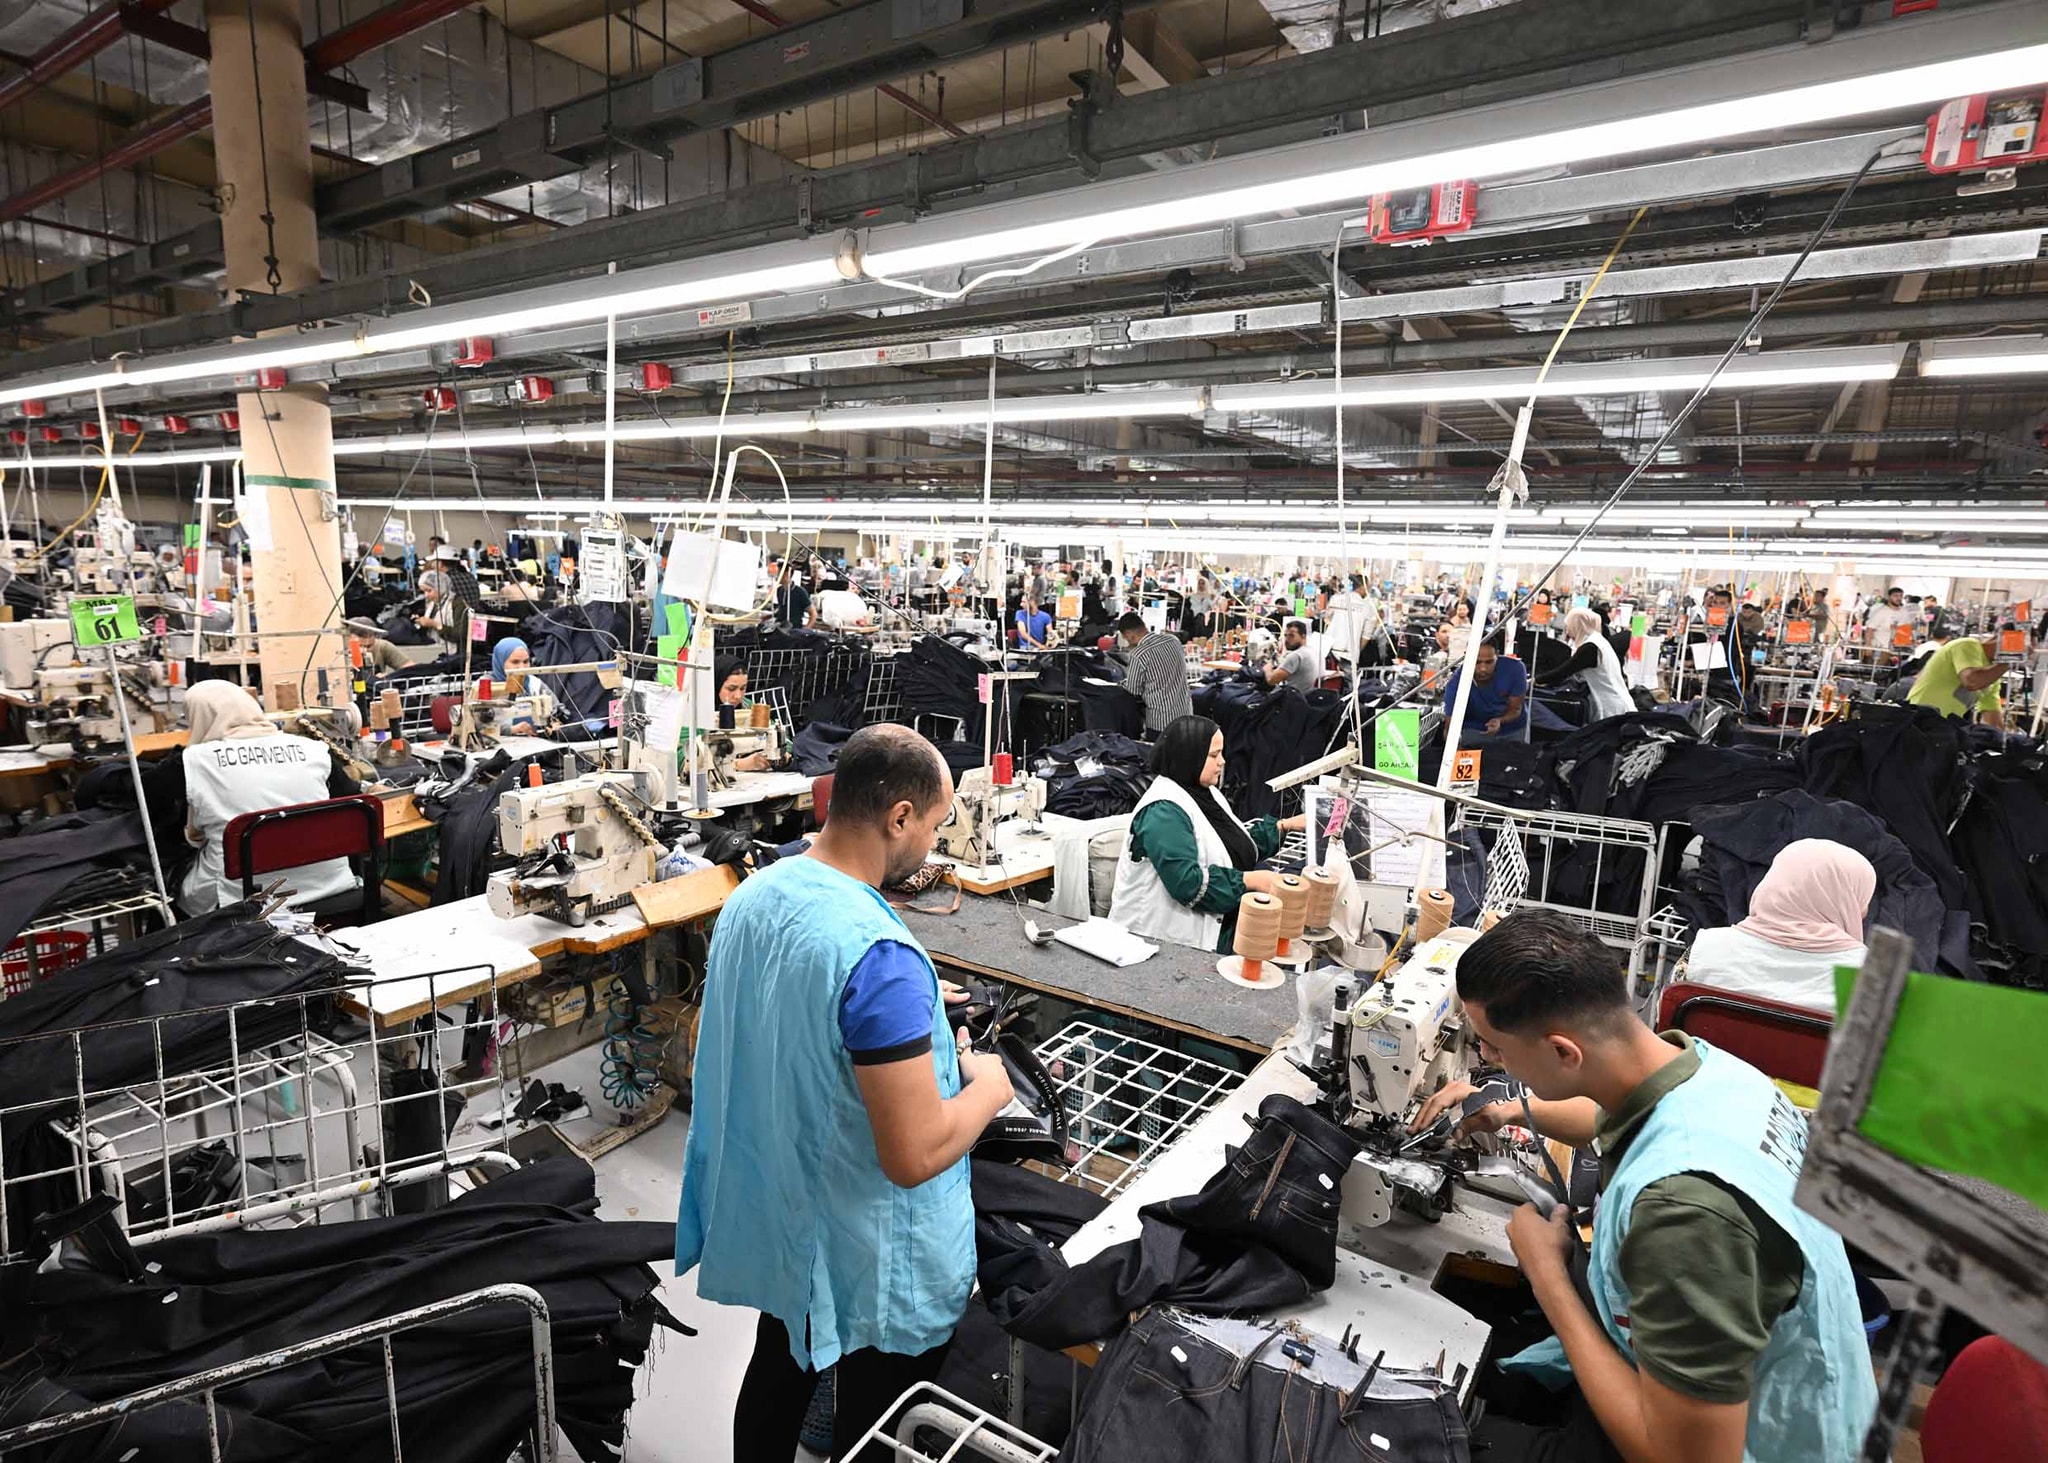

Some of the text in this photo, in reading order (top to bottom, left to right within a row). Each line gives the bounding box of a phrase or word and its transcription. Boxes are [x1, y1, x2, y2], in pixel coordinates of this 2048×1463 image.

[94, 616, 122, 641] 61
[237, 744, 306, 765] GARMENTS
[1456, 764, 1473, 780] 82
